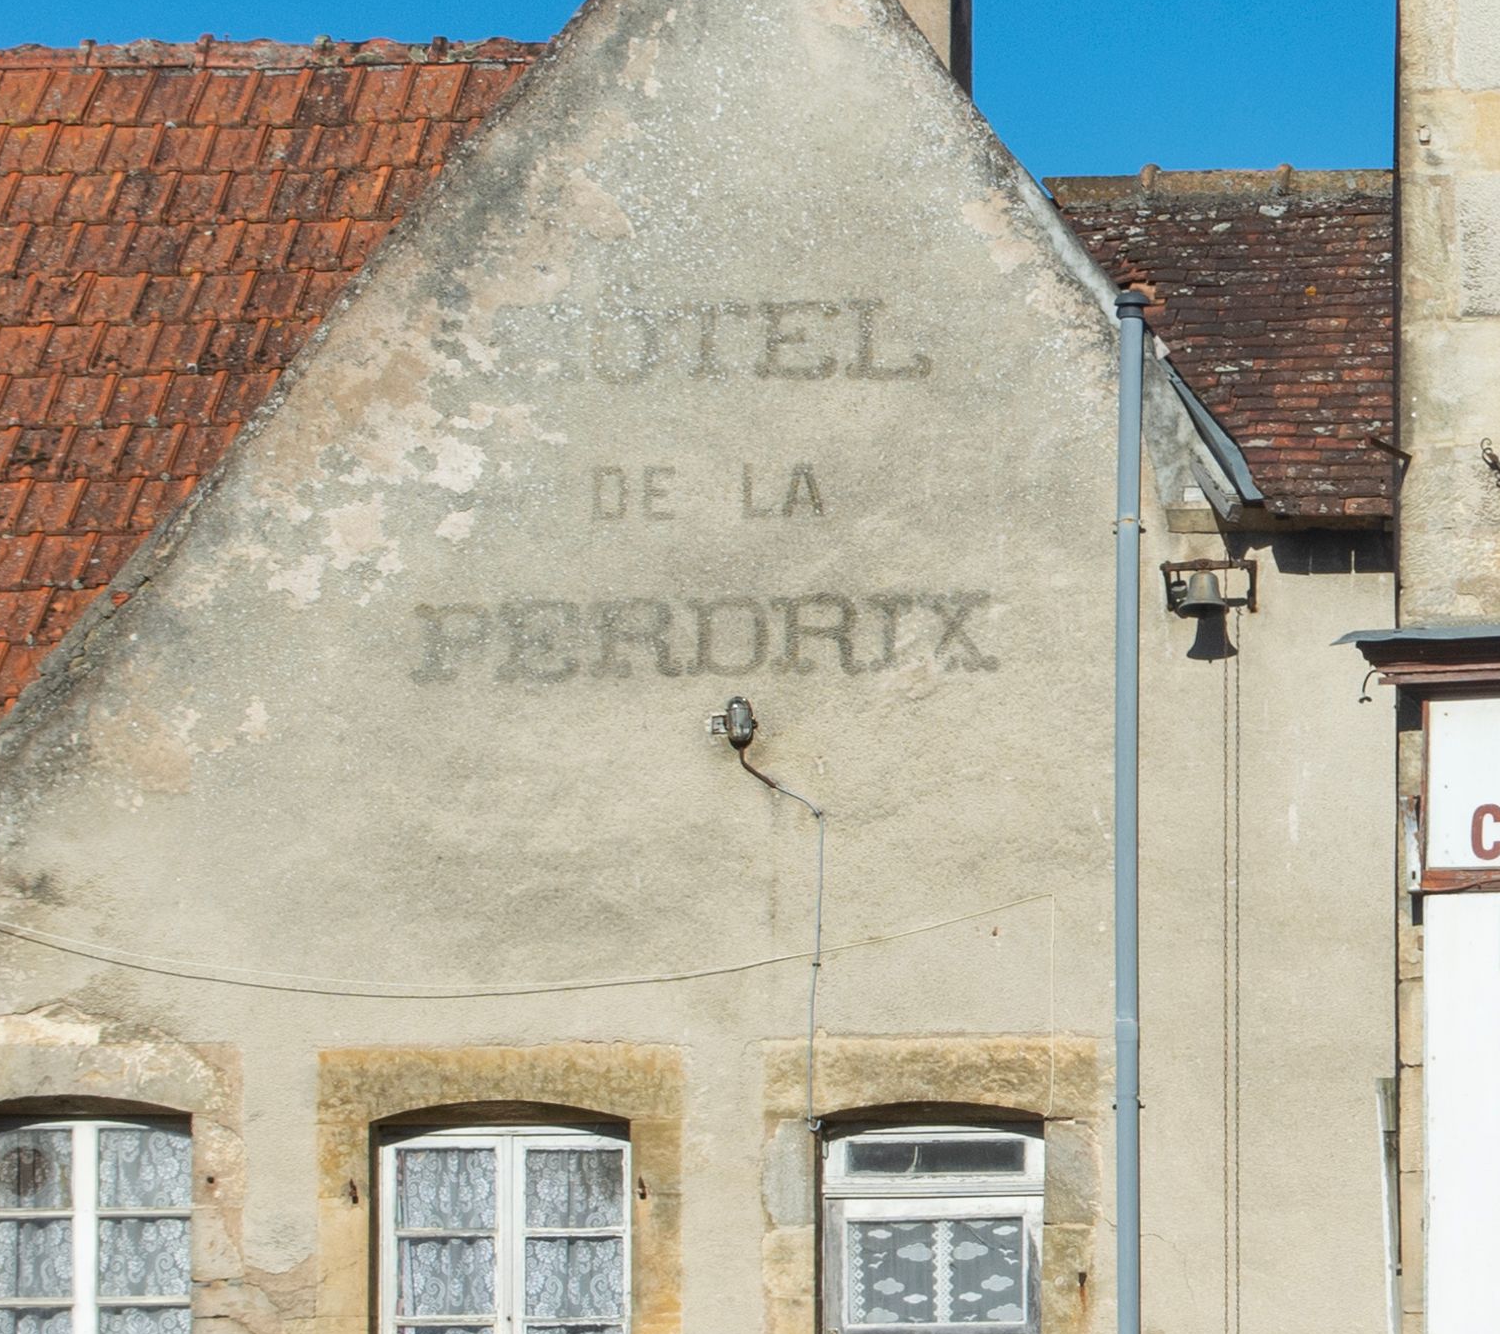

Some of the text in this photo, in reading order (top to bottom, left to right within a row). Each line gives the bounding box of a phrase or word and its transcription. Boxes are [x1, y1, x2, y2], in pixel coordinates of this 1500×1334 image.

[590, 462, 828, 522] DE LA
[409, 590, 1002, 685] PERDRIX
